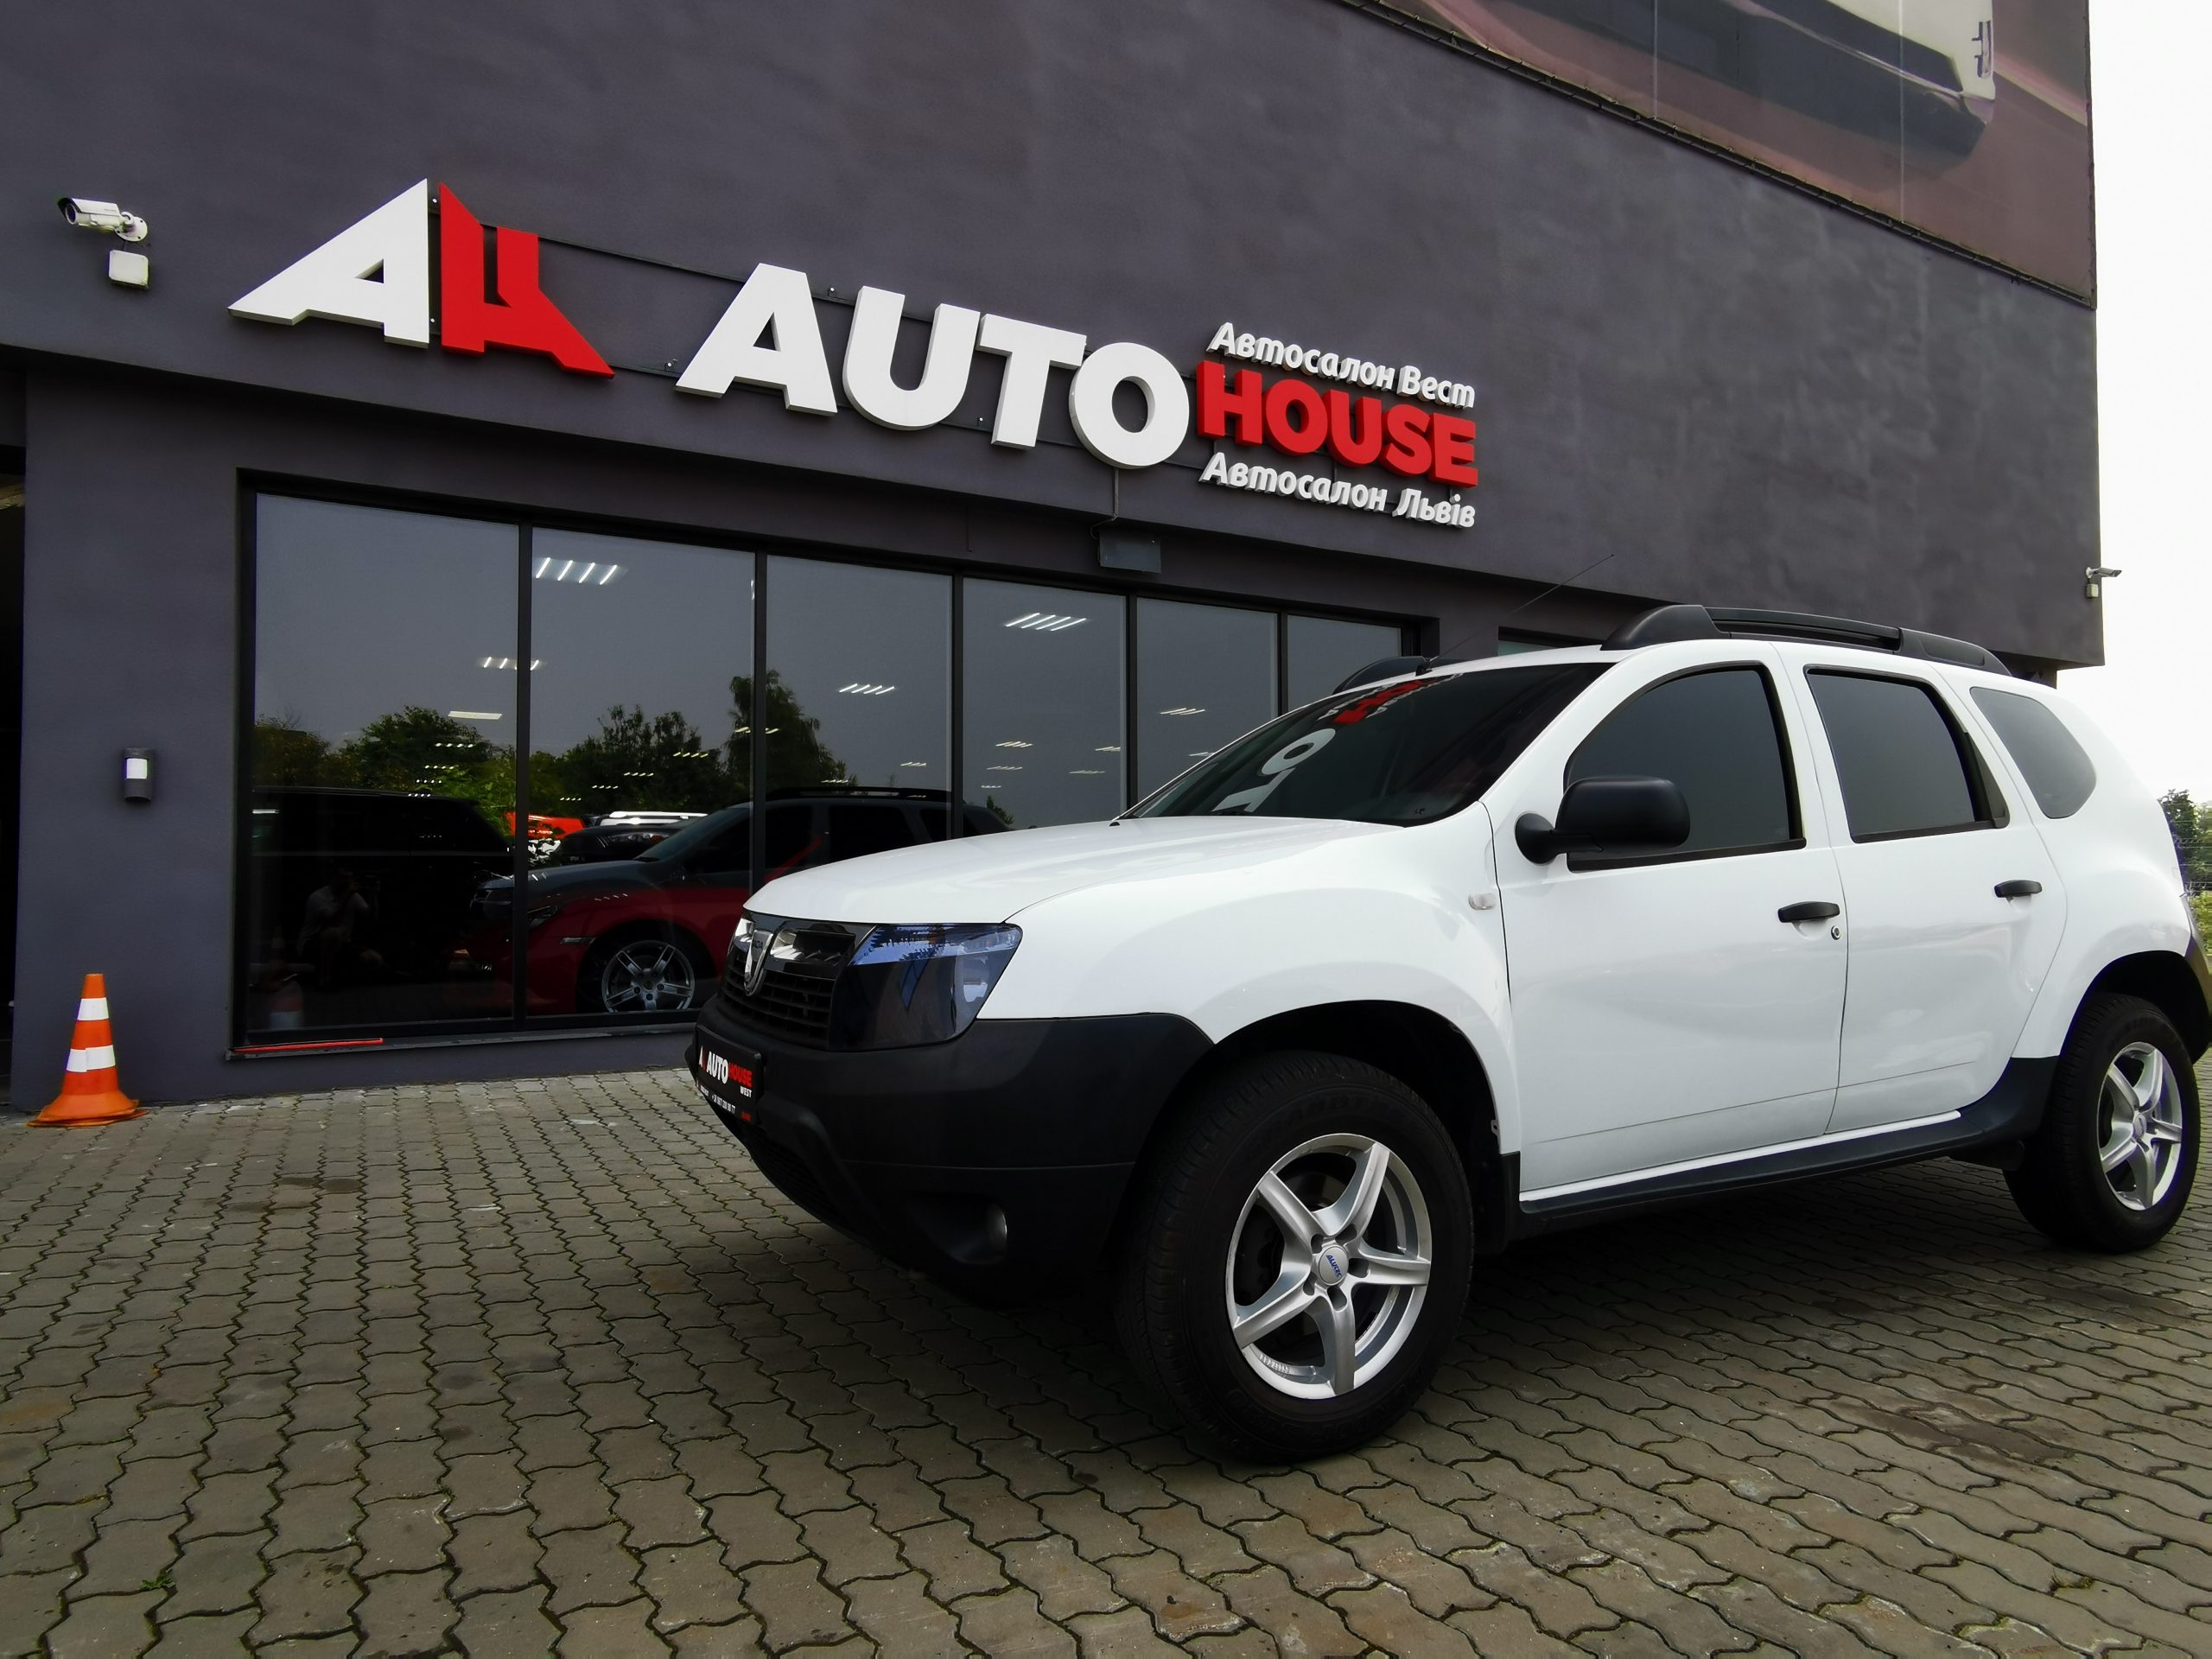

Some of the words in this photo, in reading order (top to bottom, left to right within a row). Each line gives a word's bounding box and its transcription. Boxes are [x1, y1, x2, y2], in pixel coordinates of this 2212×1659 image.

[675, 263, 1190, 469] AUTO
[1197, 360, 1478, 487] HOUSE
[1206, 322, 1395, 391] Автосалон
[1396, 365, 1475, 409] Вест
[1198, 452, 1388, 512] Автосалон
[1392, 488, 1476, 528] Львів
